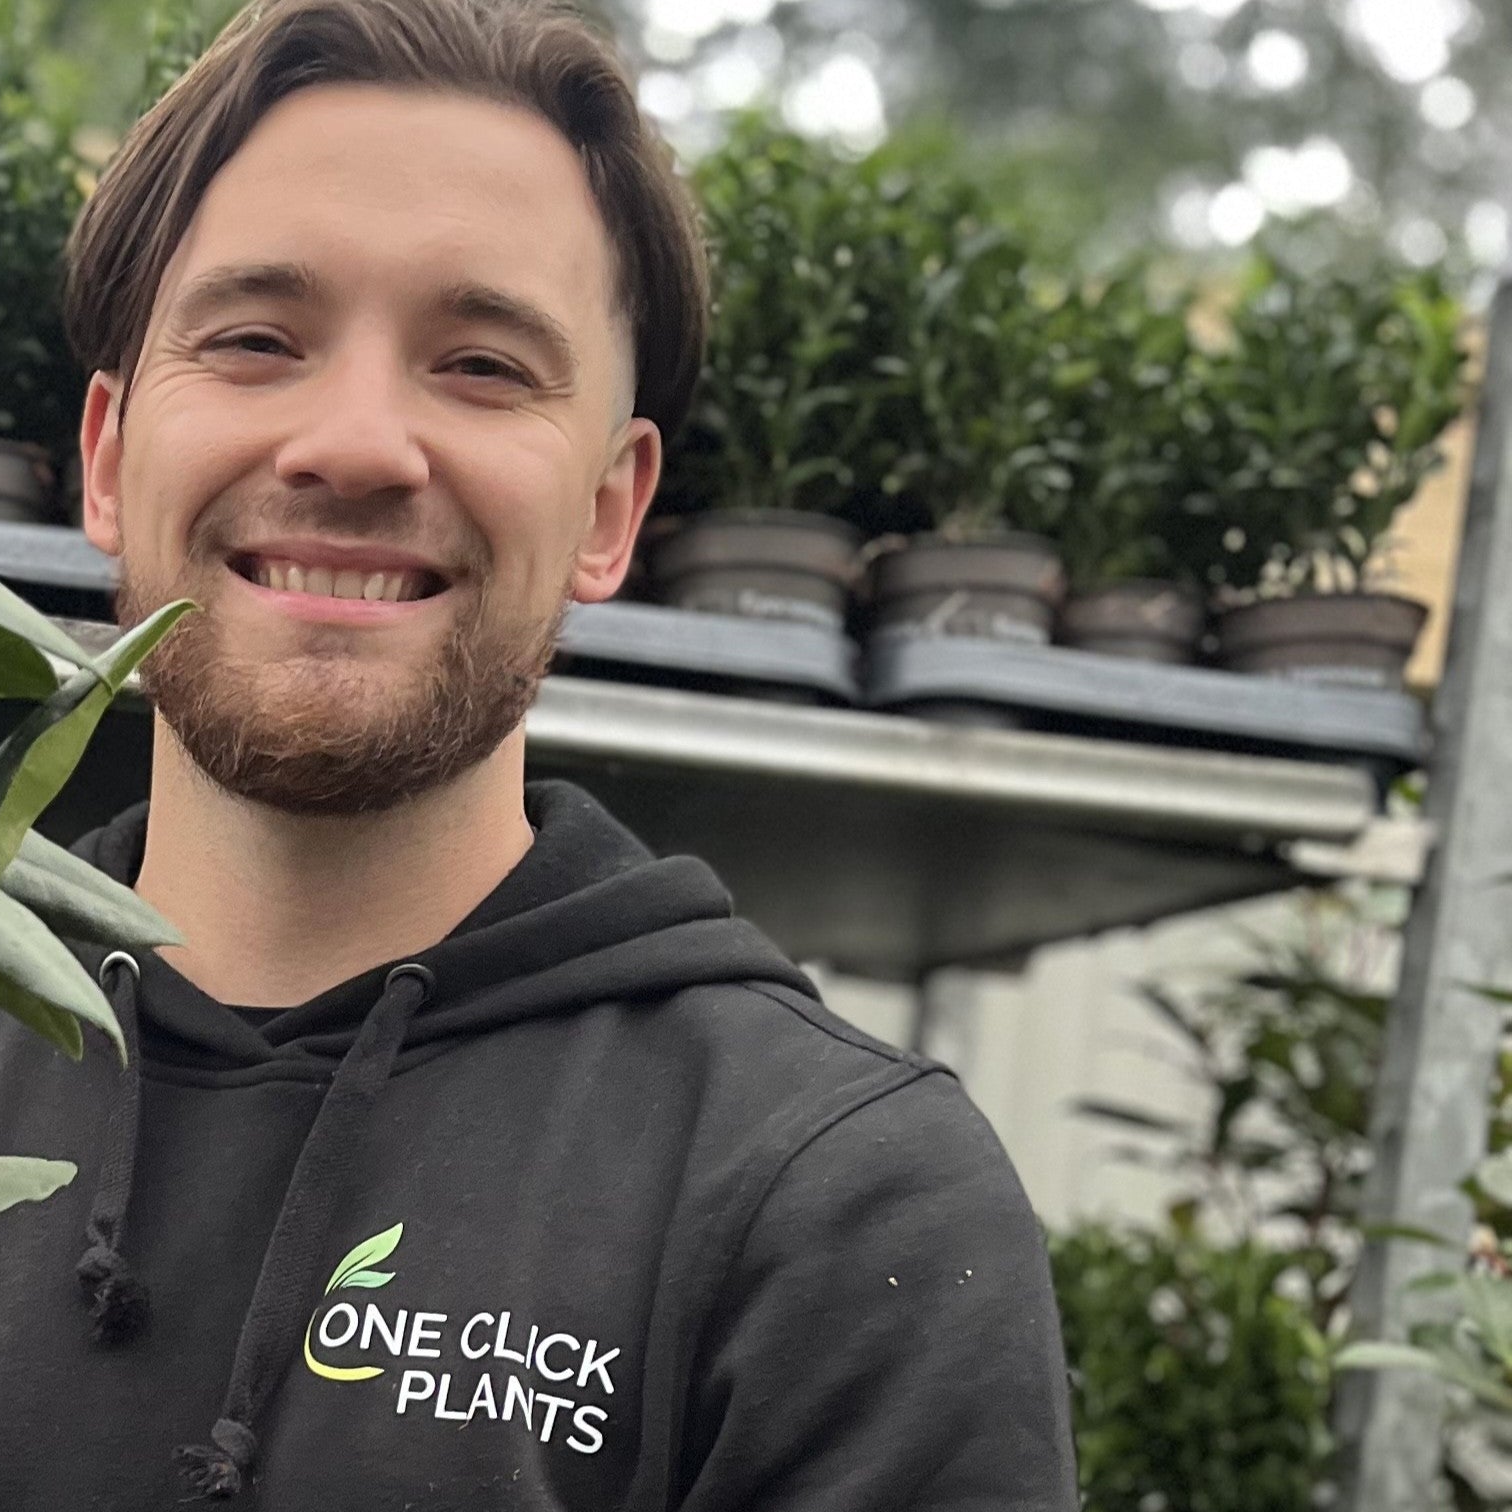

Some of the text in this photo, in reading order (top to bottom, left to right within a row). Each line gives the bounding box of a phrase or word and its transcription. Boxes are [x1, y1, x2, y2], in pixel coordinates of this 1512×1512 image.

[319, 1302, 621, 1394] ONE CLICK
[396, 1369, 609, 1454] PLANTS
